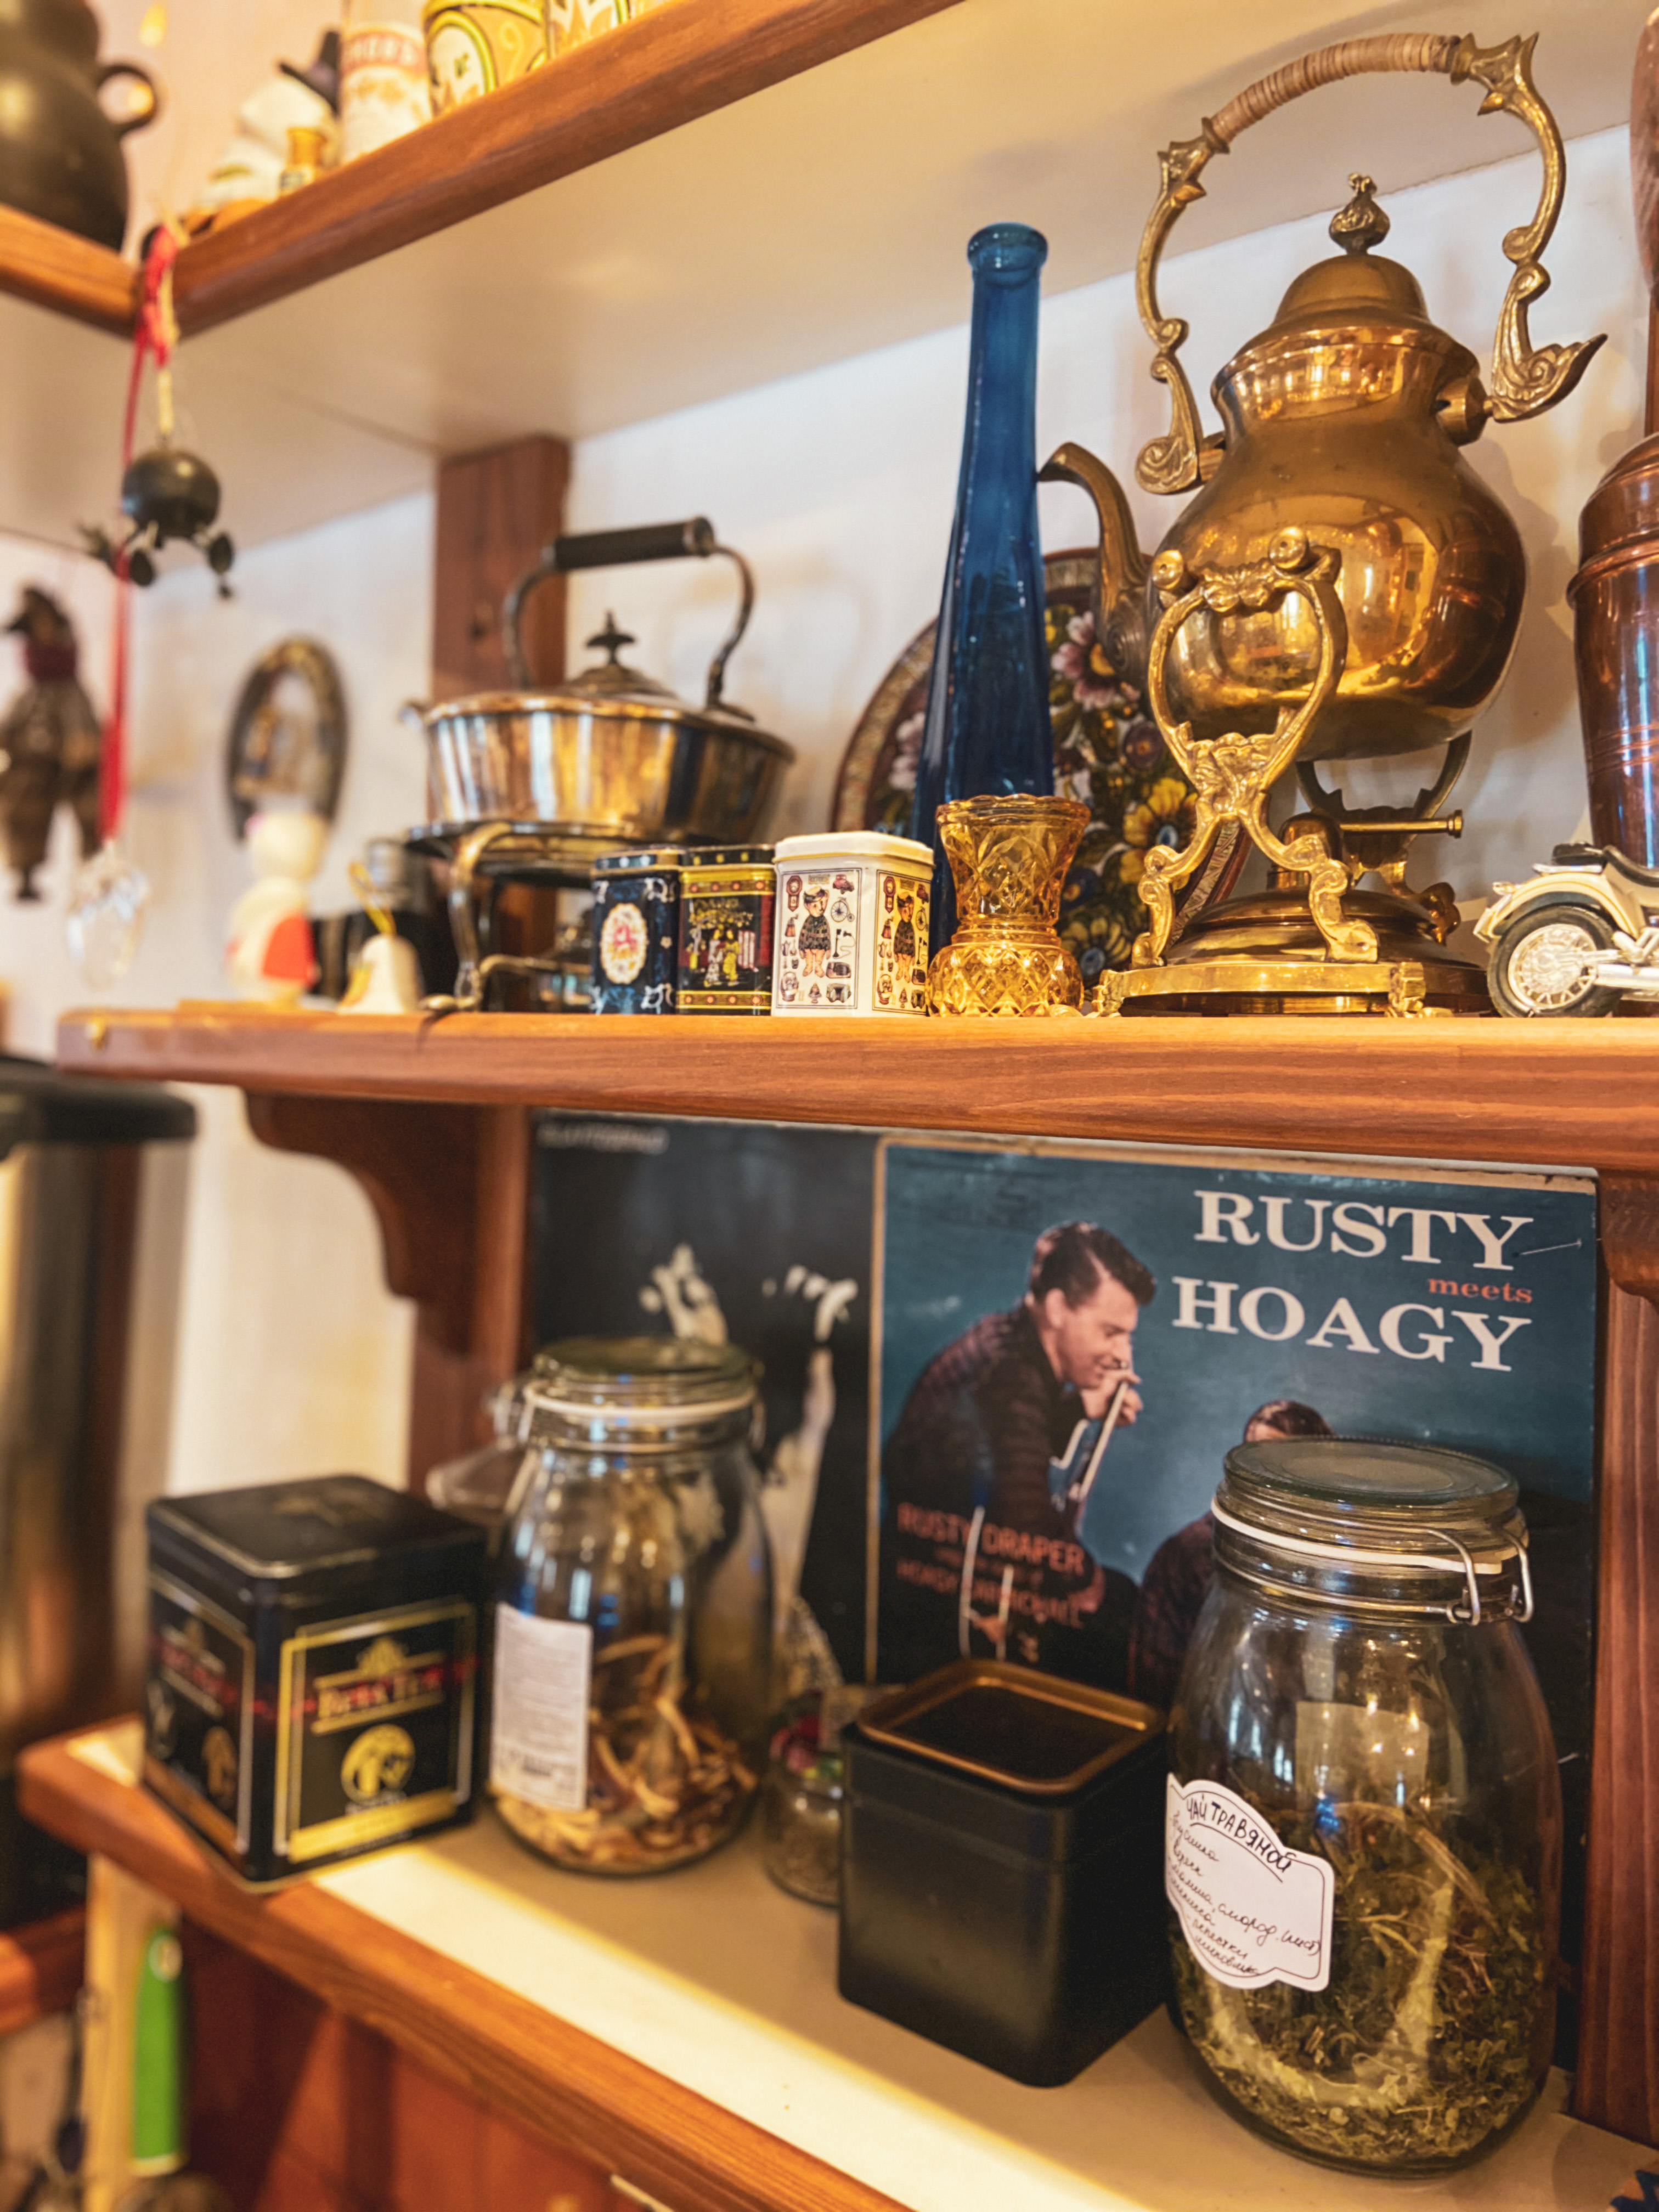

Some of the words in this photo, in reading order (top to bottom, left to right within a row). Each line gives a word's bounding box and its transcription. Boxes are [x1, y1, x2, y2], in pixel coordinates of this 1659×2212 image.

[1194, 1189, 1534, 1271] RUSTY
[1172, 1276, 1532, 1372] HOAGY
[1427, 1277, 1533, 1304] meets
[981, 1522, 1085, 1576] DRAPER
[1186, 1794, 1207, 1821] ЧАЙ
[1211, 1801, 1297, 1873] ТРАВЯНОЙ
